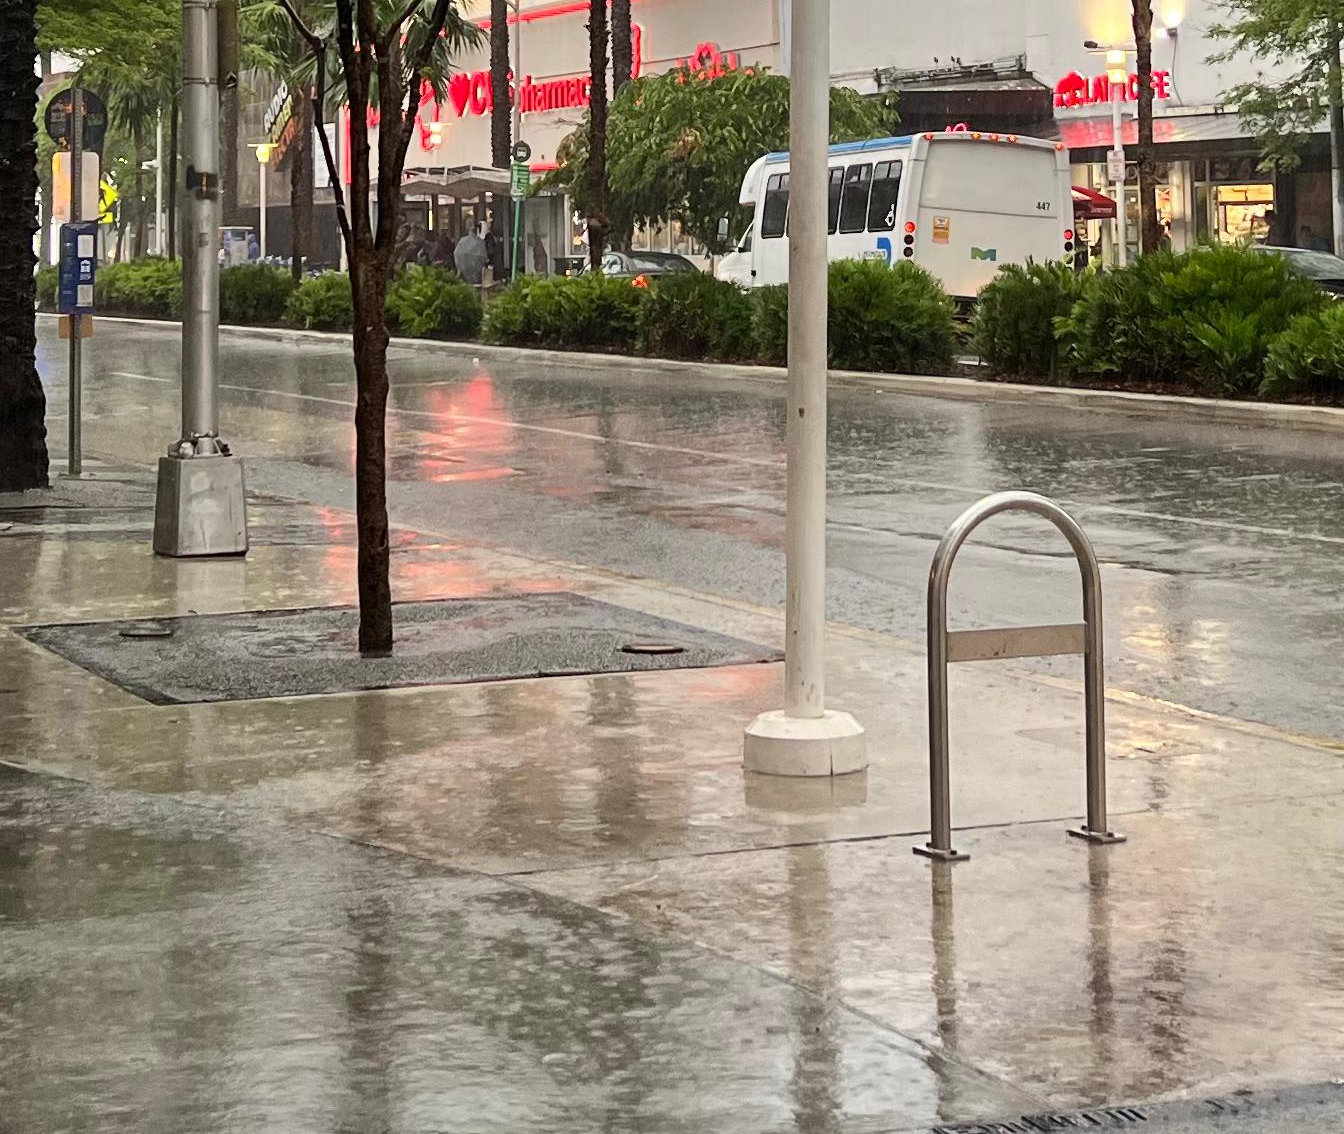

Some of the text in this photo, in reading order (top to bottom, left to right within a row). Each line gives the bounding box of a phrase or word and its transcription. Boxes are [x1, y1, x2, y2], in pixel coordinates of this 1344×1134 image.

[518, 74, 592, 115] pharmac
[1127, 69, 1171, 101] CFE
[1035, 201, 1051, 211] 447
